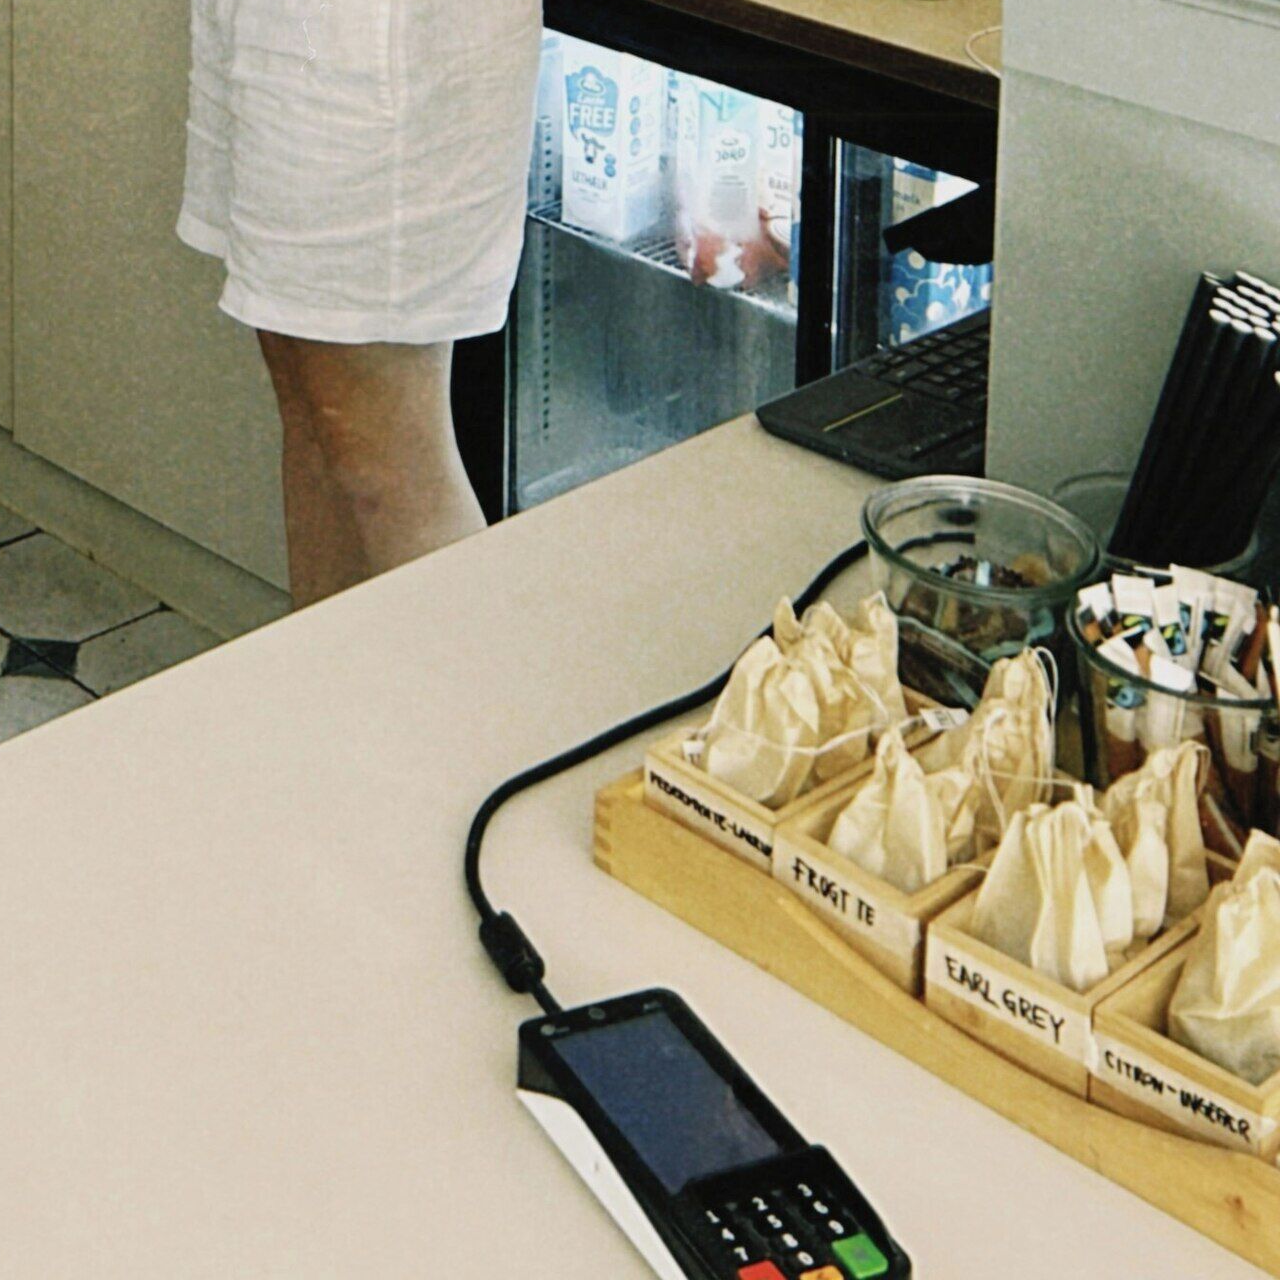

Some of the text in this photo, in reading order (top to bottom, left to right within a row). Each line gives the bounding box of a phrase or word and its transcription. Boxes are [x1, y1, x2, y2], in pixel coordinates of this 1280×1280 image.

[570, 102, 616, 128] FREE
[856, 897, 875, 927] TE
[944, 954, 1066, 1044] EARL GREY
